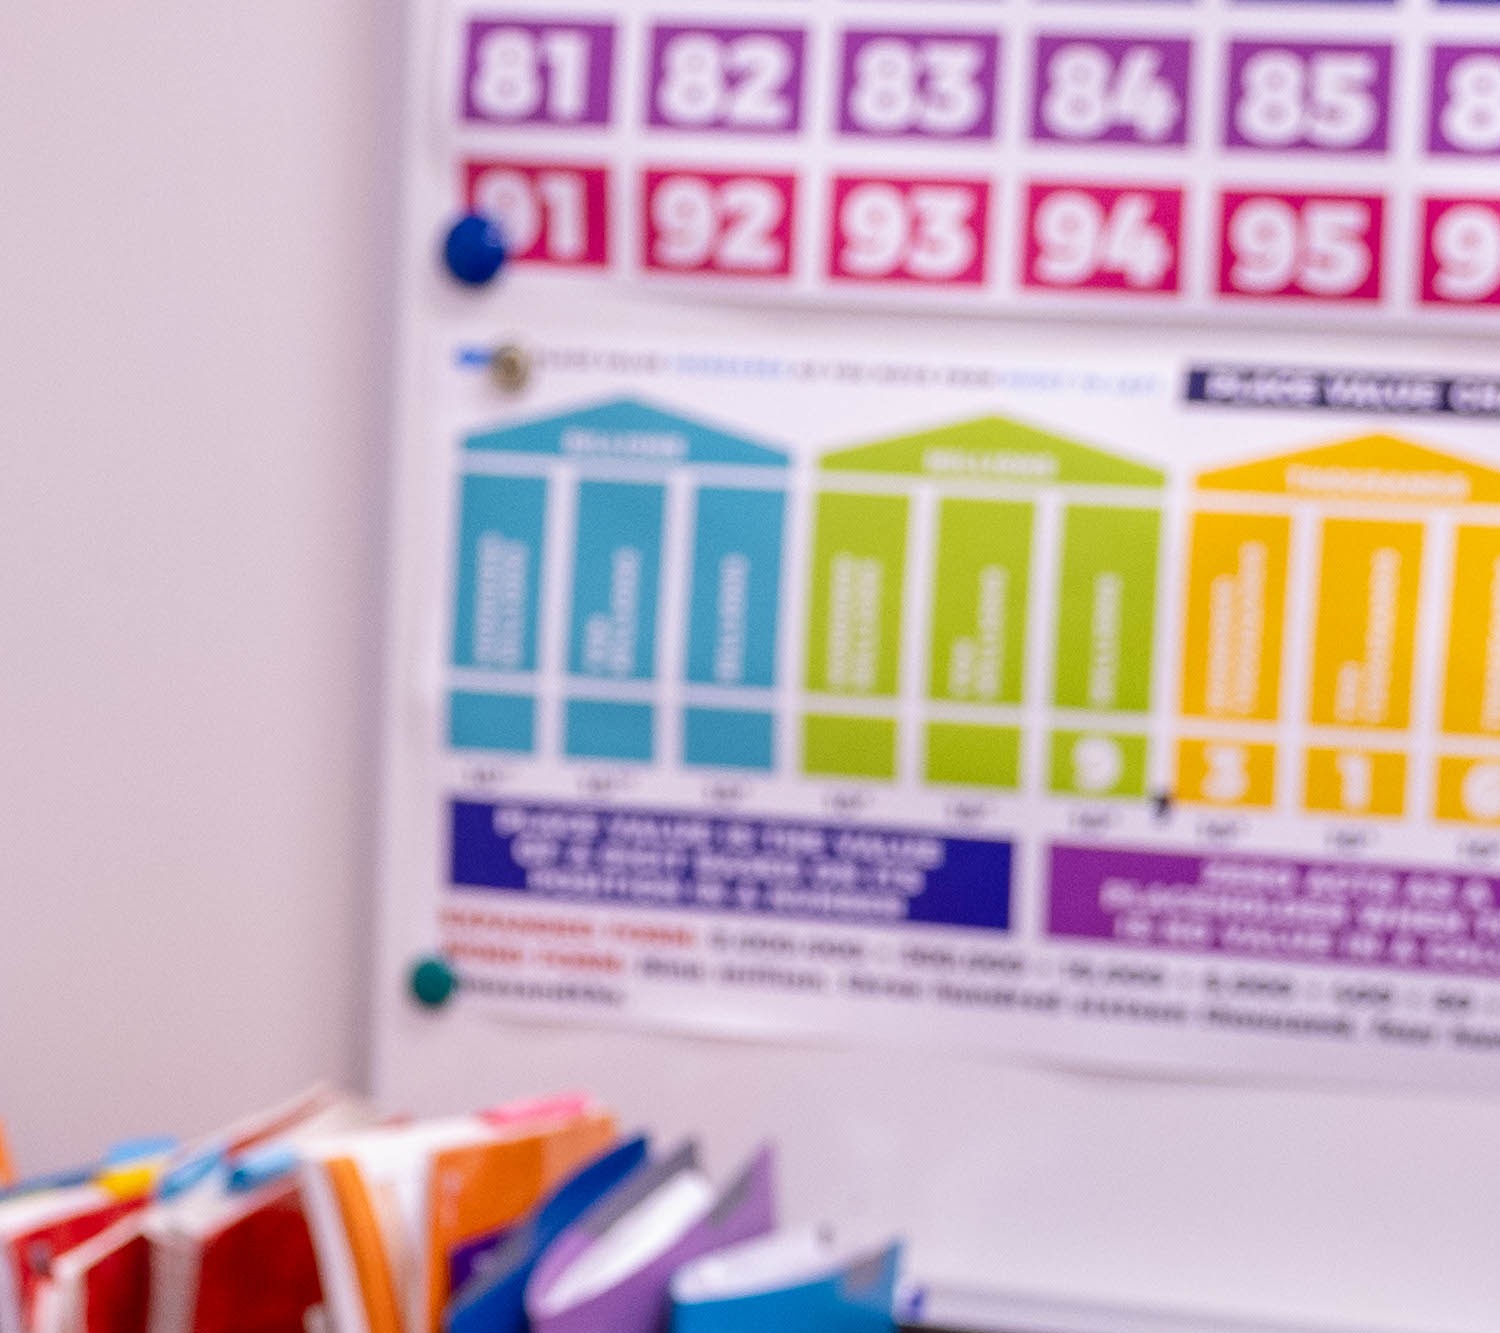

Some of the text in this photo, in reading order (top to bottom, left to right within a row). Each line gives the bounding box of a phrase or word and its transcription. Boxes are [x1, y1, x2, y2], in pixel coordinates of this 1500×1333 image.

[472, 27, 589, 121] 81
[658, 31, 793, 126] 82
[850, 37, 984, 133] 83
[1042, 42, 1180, 141] 84
[1236, 49, 1379, 149] 85
[651, 175, 787, 271] 92
[840, 181, 977, 276] 93
[1034, 191, 1173, 287] 94
[1230, 197, 1373, 295] 95
